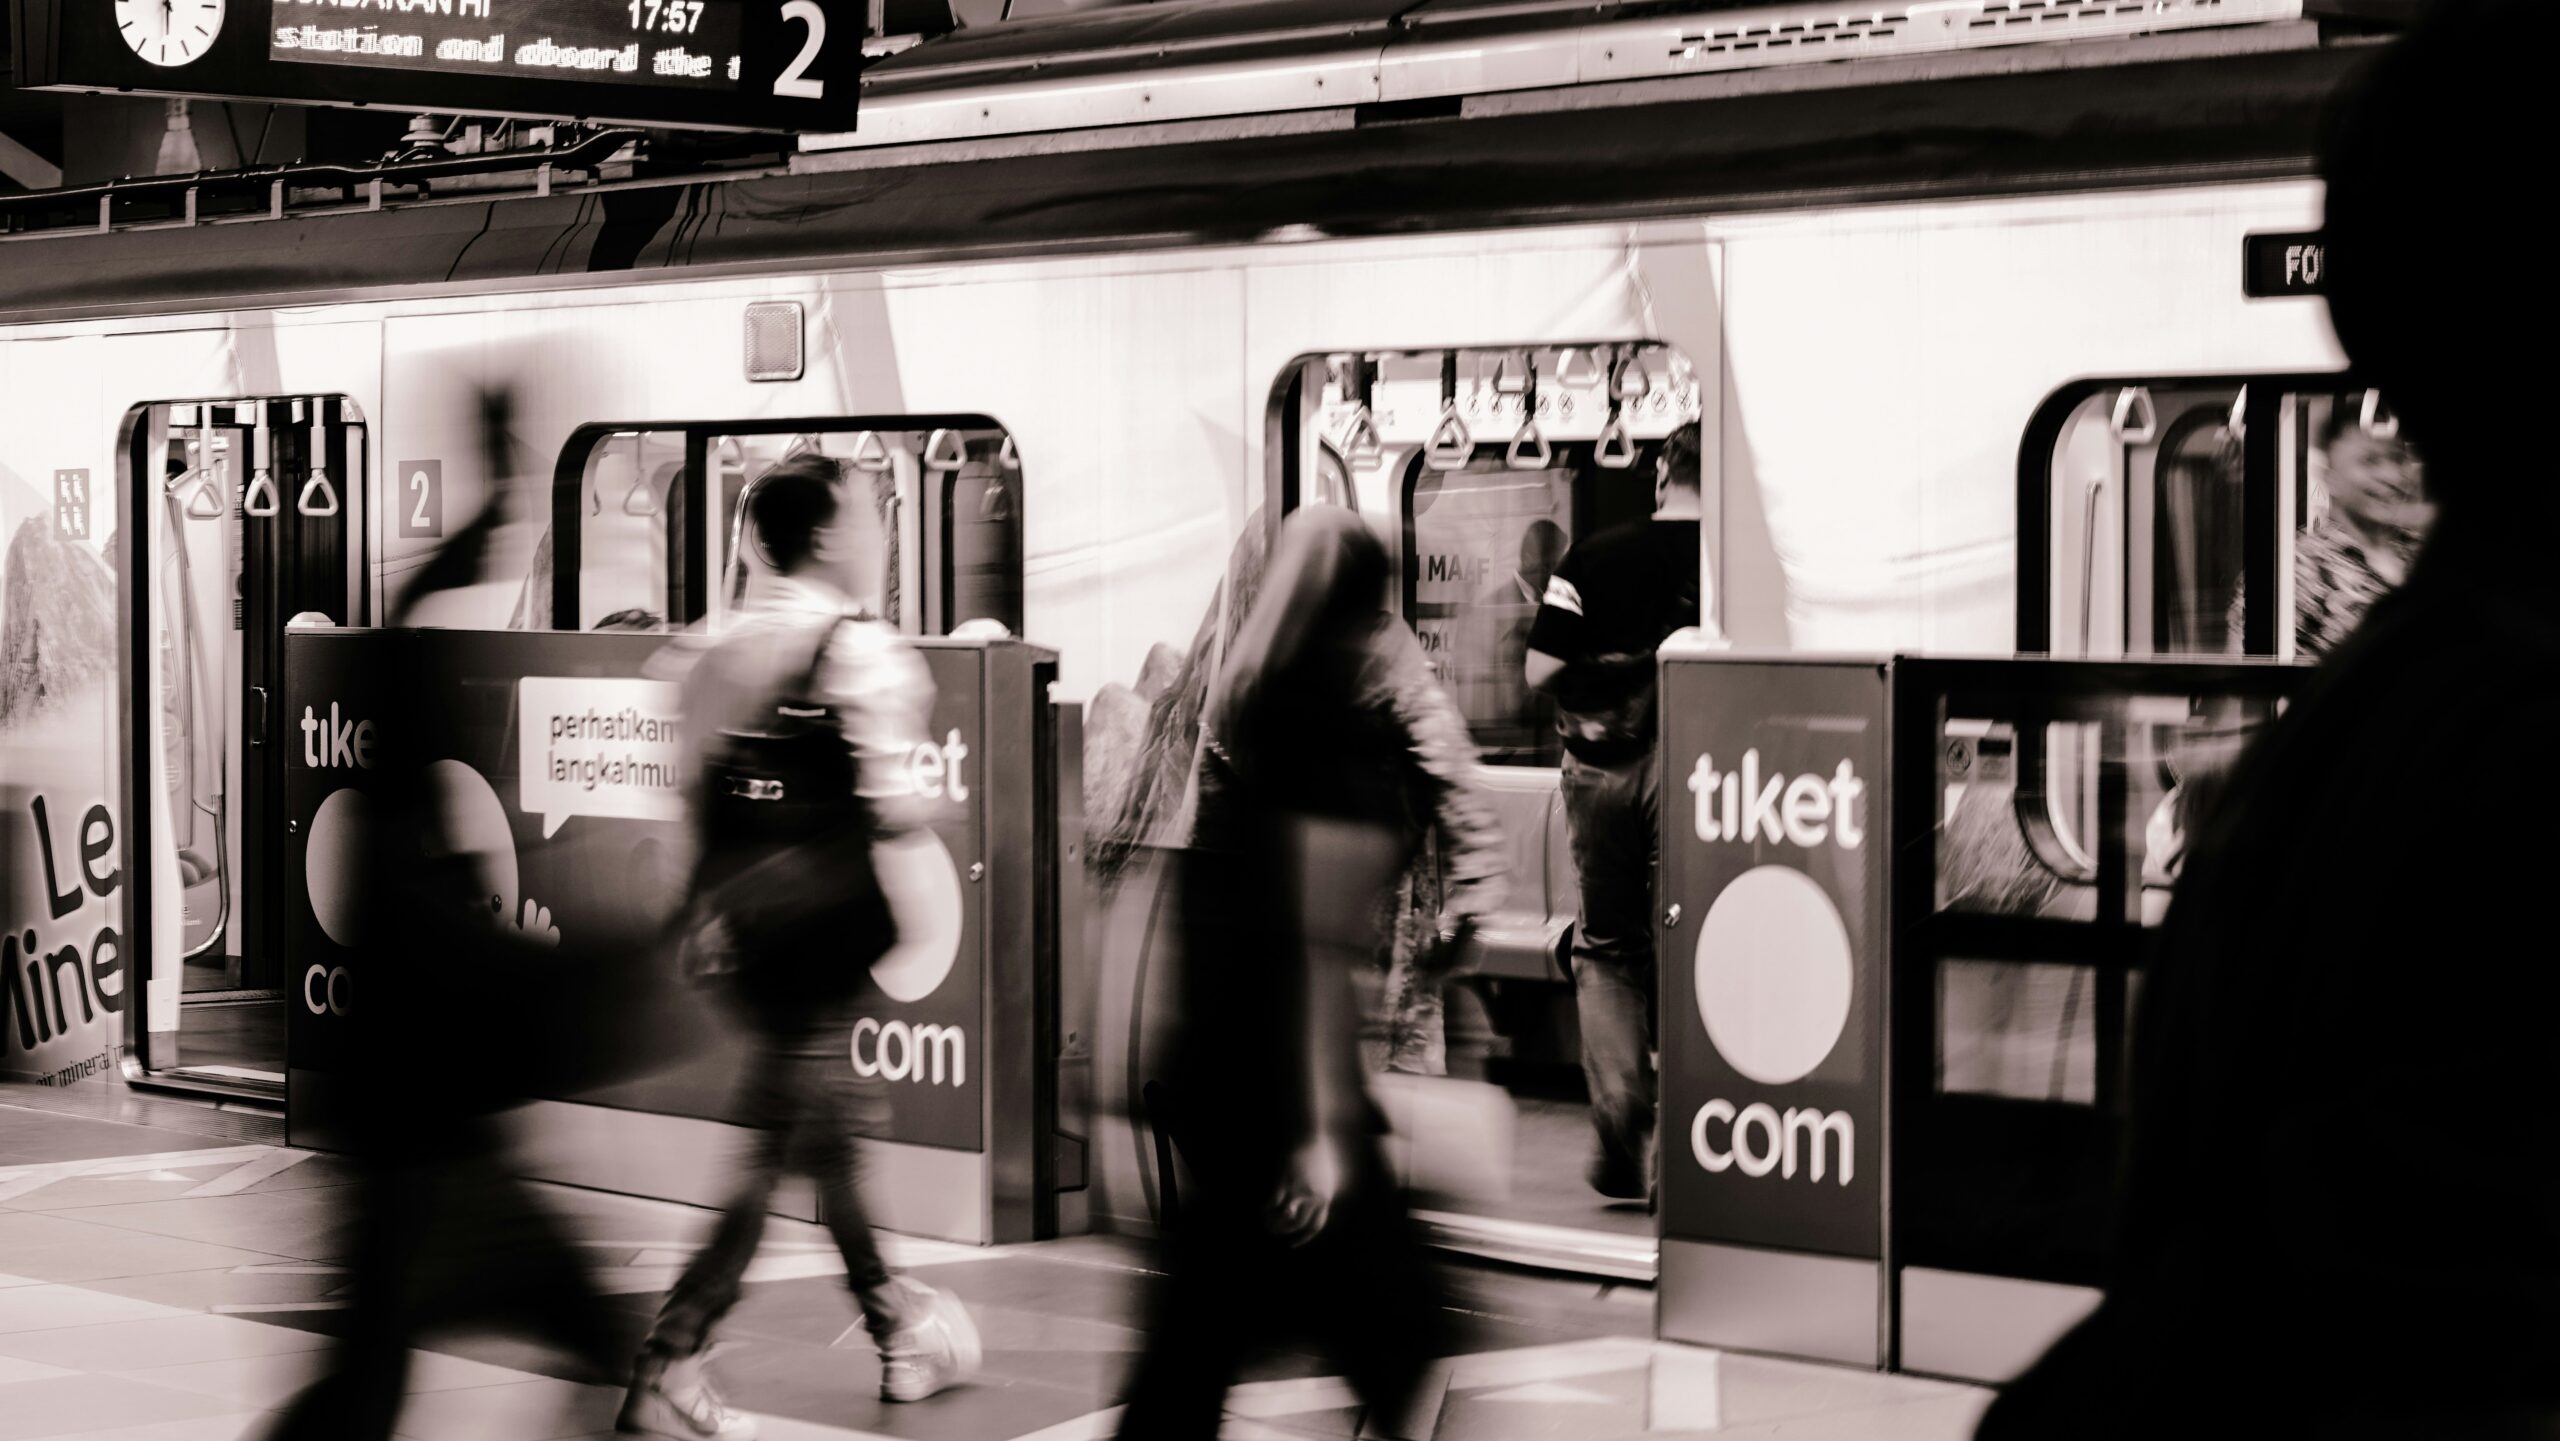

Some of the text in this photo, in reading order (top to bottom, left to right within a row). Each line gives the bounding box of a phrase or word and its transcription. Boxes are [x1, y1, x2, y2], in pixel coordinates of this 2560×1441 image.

[628, 0, 704, 33] 17:57
[772, 0, 827, 99] 2
[2285, 244, 2324, 286] FO
[410, 470, 431, 528] 2
[300, 701, 380, 769] tike
[550, 707, 675, 746] perhatikan
[548, 750, 676, 791] langkahmu
[30, 794, 123, 921] Le
[304, 963, 353, 1017] co
[58, 1044, 110, 1088] mineral
[850, 1016, 966, 1088] com
[1691, 1098, 1855, 1187] com
